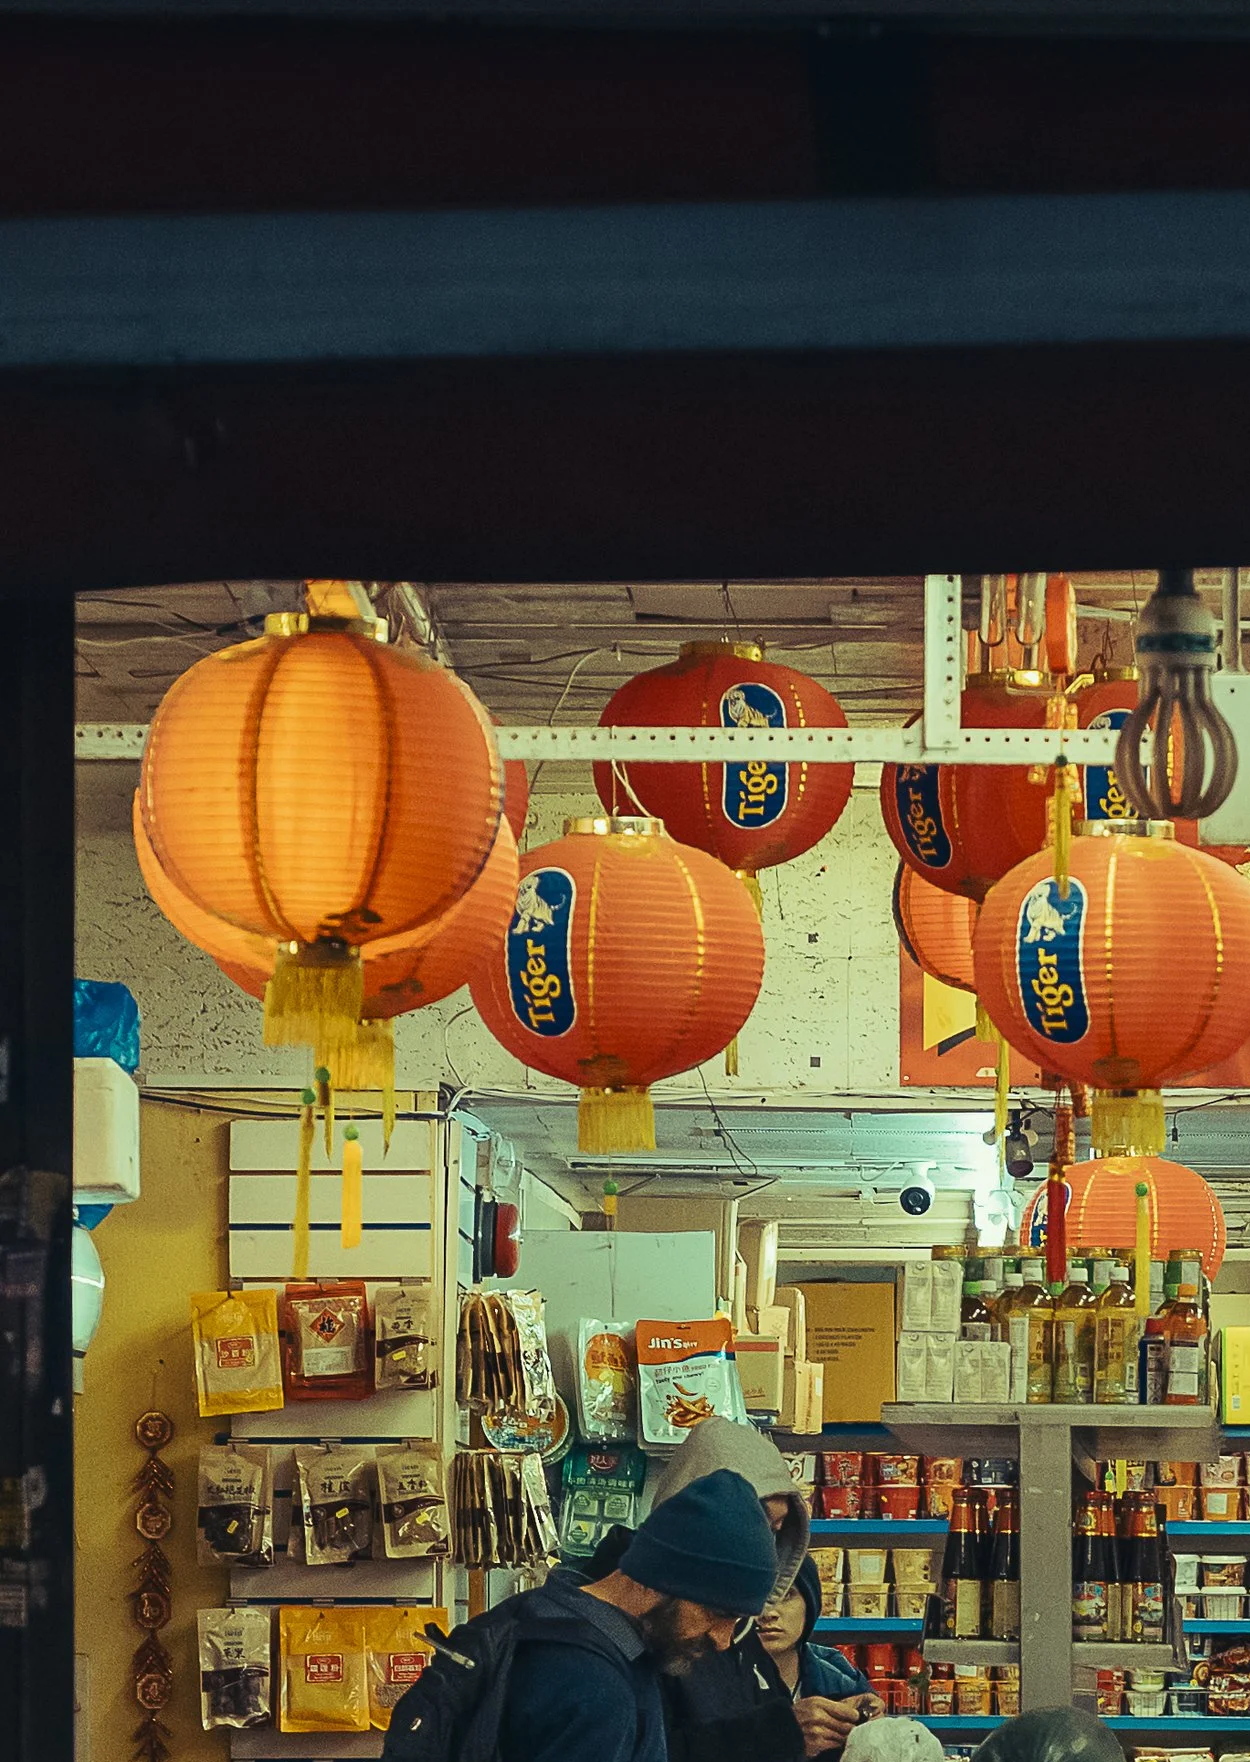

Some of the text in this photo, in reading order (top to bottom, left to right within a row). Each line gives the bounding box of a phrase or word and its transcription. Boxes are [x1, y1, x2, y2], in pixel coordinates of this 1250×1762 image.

[738, 760, 778, 821] Tige
[905, 788, 938, 863] Tiger
[520, 938, 562, 1028] Tiger
[1031, 948, 1073, 1035] Tiger
[648, 1337, 683, 1349] Jin's
